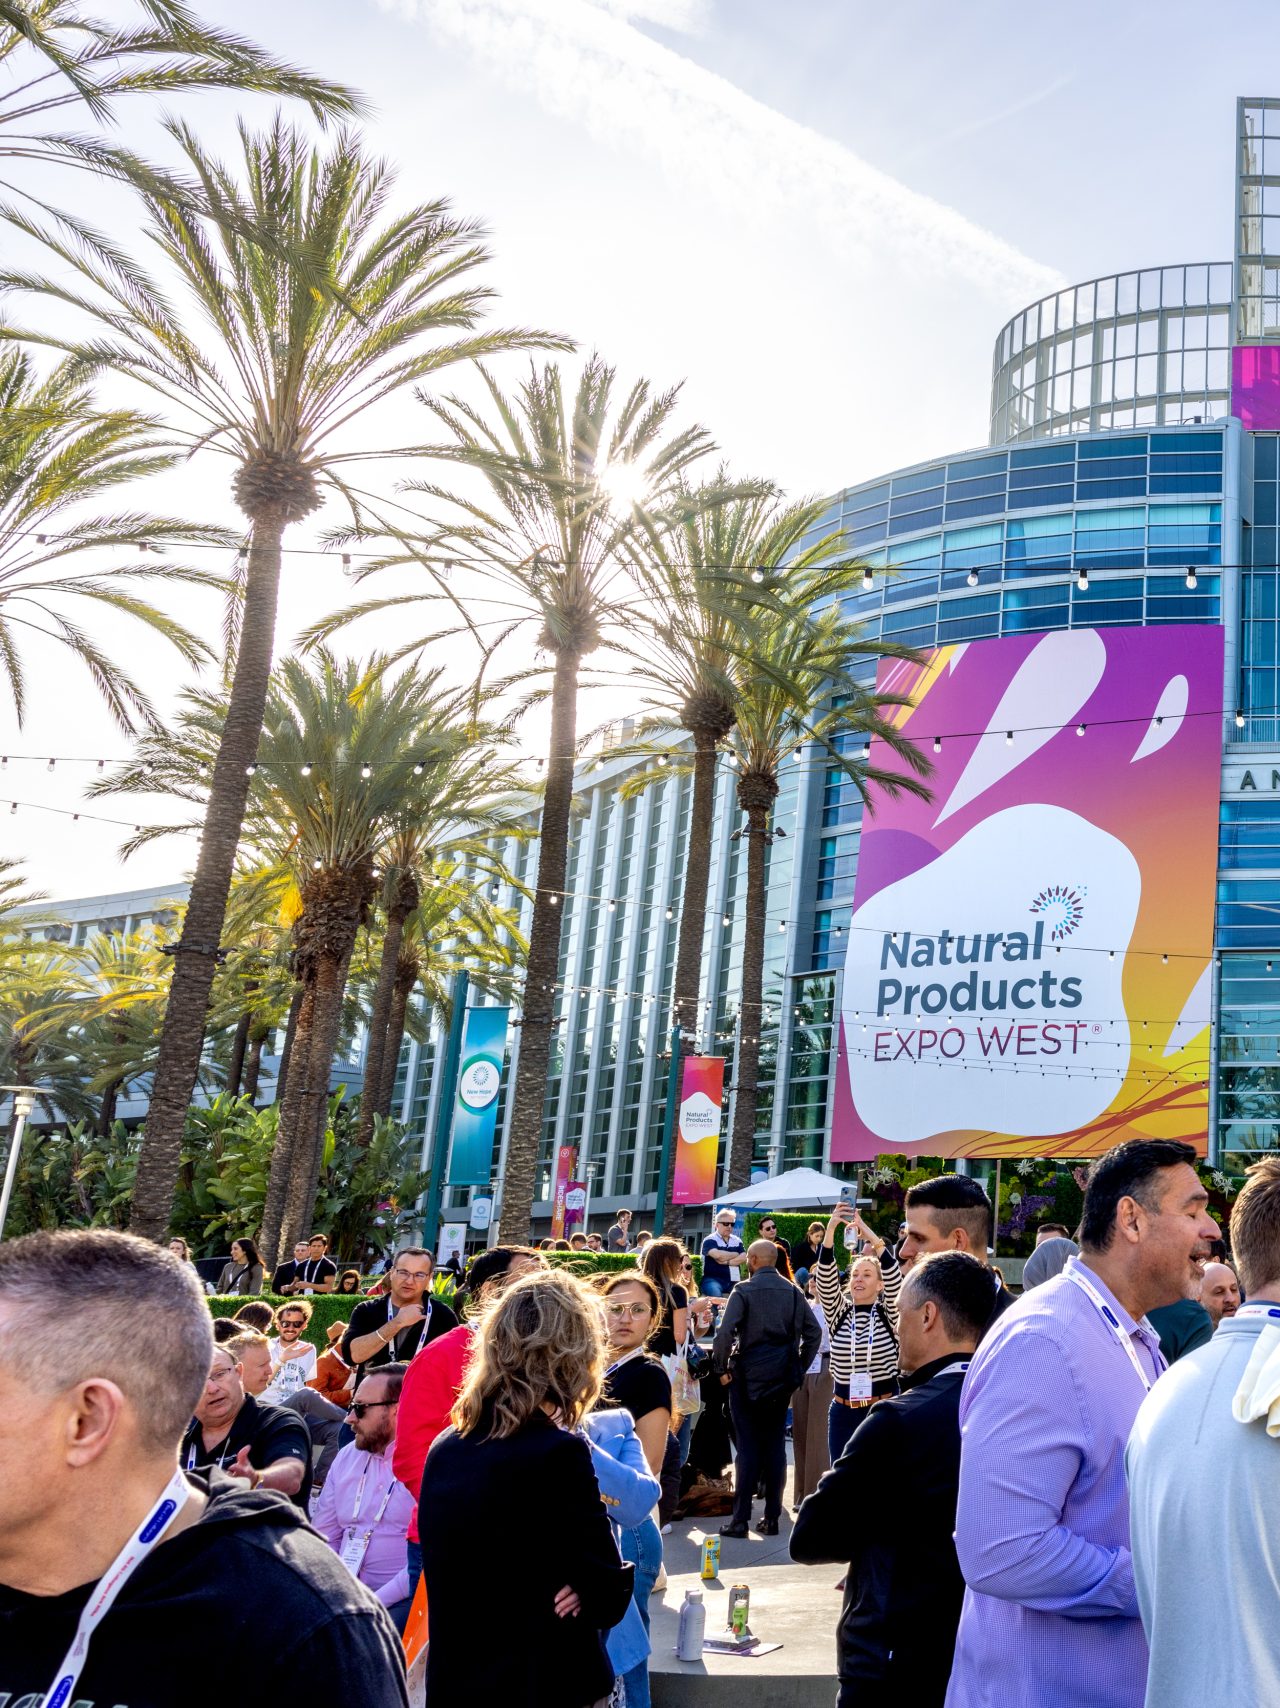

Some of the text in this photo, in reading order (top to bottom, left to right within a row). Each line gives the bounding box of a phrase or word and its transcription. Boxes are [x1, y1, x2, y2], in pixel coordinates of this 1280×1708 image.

[880, 920, 1045, 970] Natural
[877, 970, 1083, 1017] Products
[874, 1023, 1087, 1062] EXPO WEST
